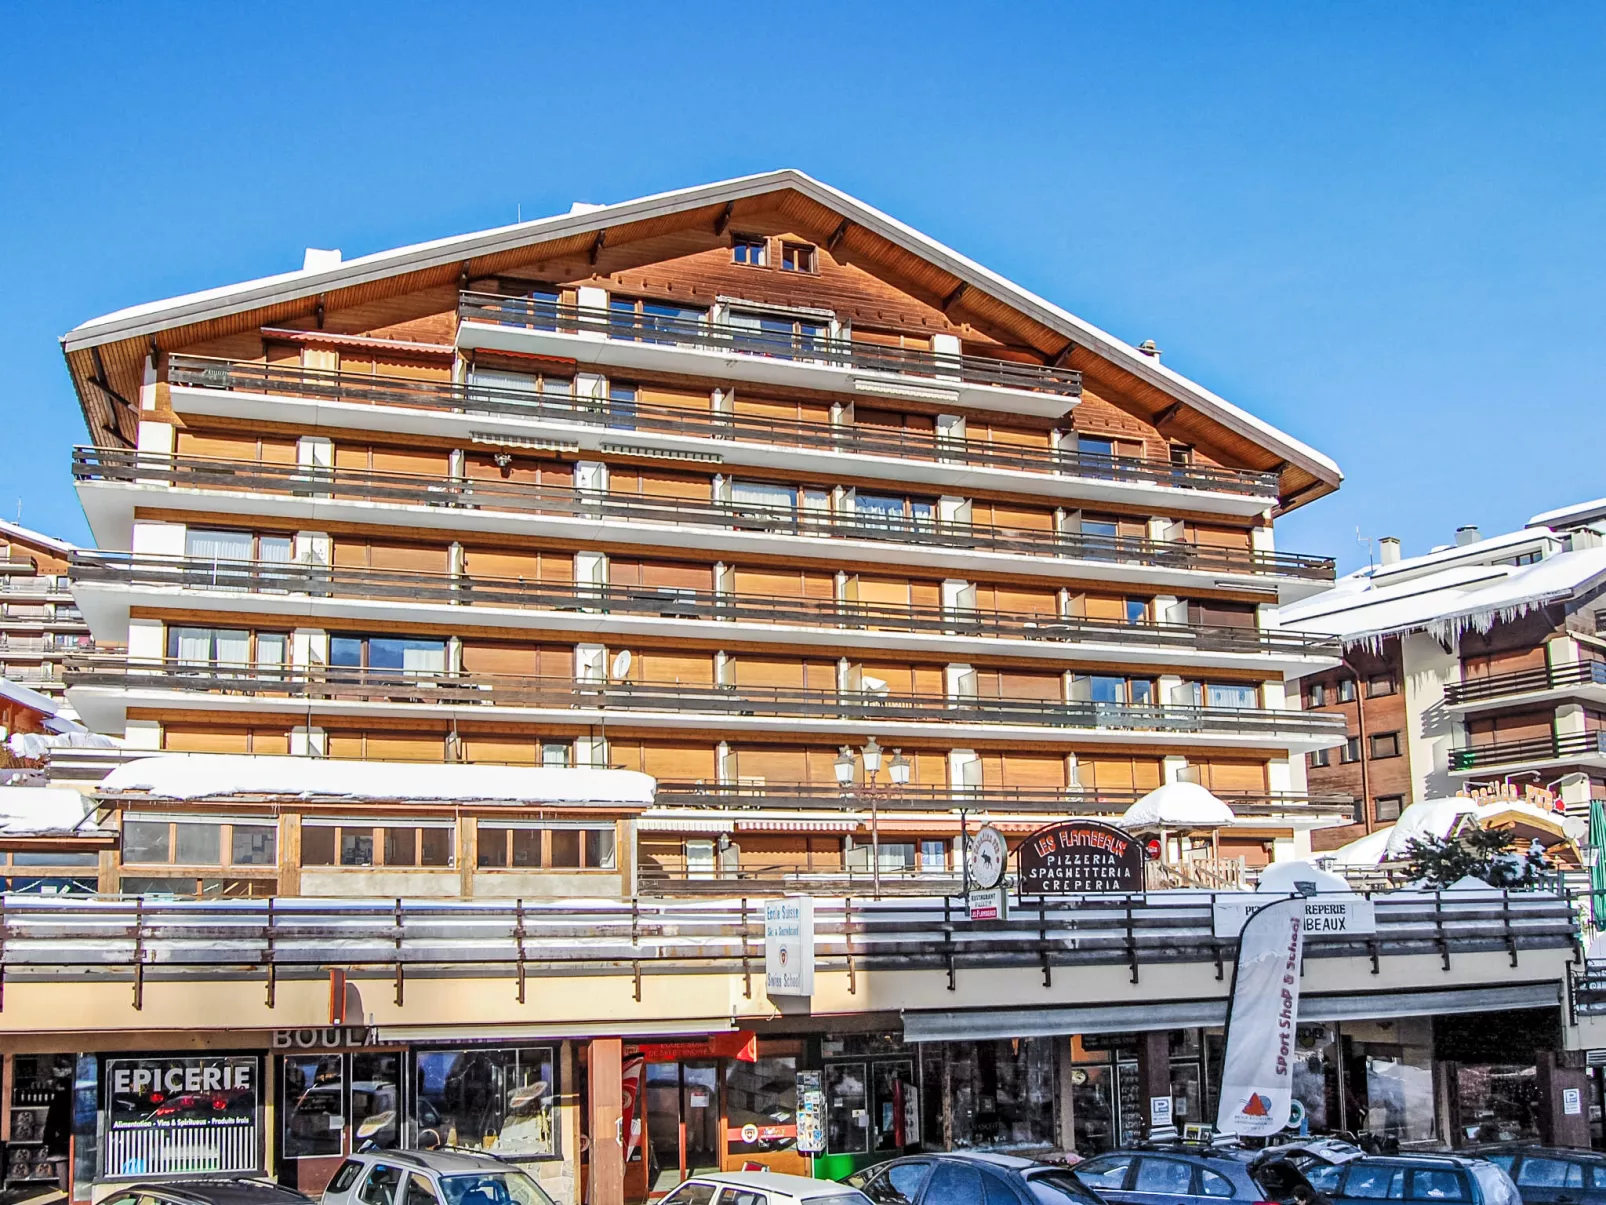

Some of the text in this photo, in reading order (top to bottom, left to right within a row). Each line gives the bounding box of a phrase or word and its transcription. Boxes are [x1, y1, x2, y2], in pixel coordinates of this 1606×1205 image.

[1034, 835, 1057, 858] LES
[1047, 854, 1116, 866] PIZZERIA
[1029, 867, 1131, 879] SPAGHETTERIA
[1042, 880, 1120, 891] CREPERIA
[782, 904, 799, 920] Suisse
[1305, 904, 1346, 915] REPERIE
[1304, 917, 1346, 931] BEAUX
[768, 972, 800, 989] Swiss School
[114, 1066, 250, 1093] EPICERIE
[1154, 1100, 1168, 1112] P
[113, 1120, 152, 1128] Alimentation
[157, 1119, 170, 1127] Vins
[177, 1117, 207, 1127] Spiritueux
[211, 1117, 235, 1125] Produits
[236, 1116, 249, 1124] frais
